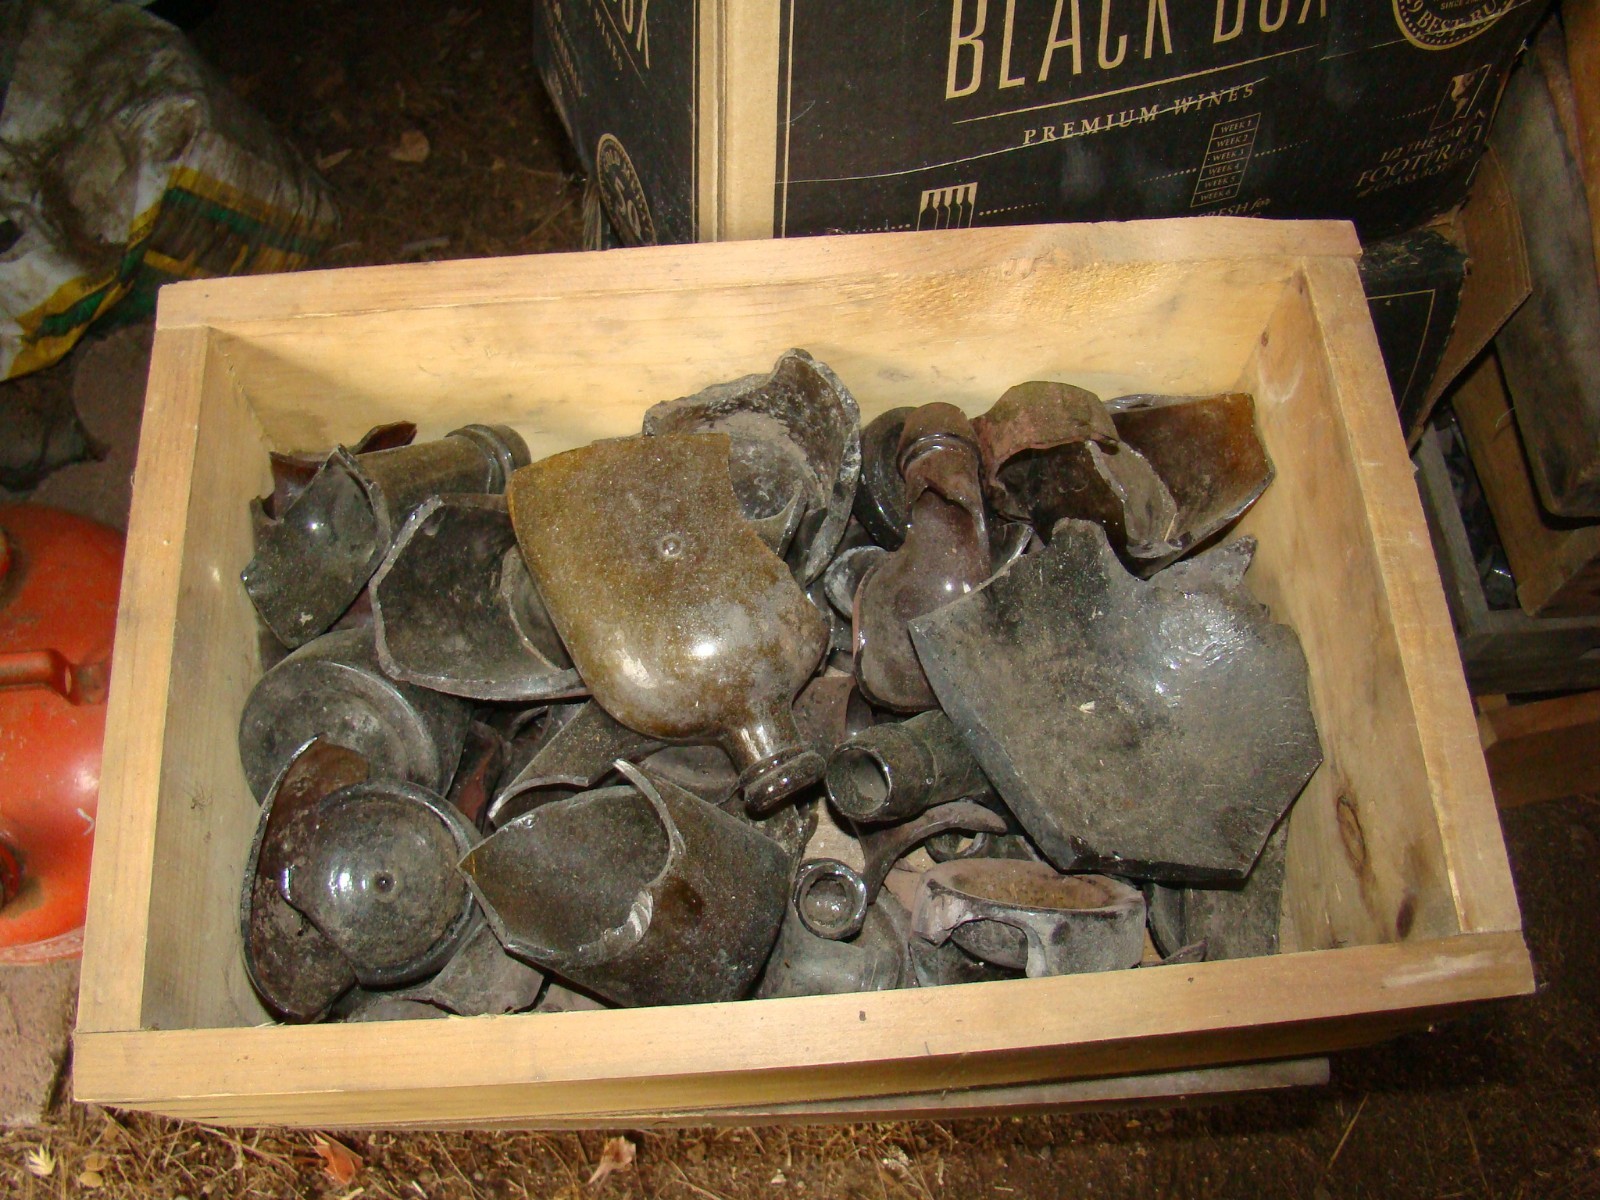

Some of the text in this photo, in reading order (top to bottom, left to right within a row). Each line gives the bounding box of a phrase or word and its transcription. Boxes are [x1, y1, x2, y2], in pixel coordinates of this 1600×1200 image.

[1416, 9, 1463, 37] BEST
[1022, 84, 1255, 145] PREMIUM WINES
[1220, 121, 1245, 134] WEEK
[1216, 136, 1241, 147] WEEK
[1212, 150, 1237, 161] WEEK
[1208, 164, 1233, 176] WEEK
[1204, 177, 1229, 188] WEEK
[1200, 190, 1225, 201] WEEK
[1198, 202, 1249, 217] RESH
